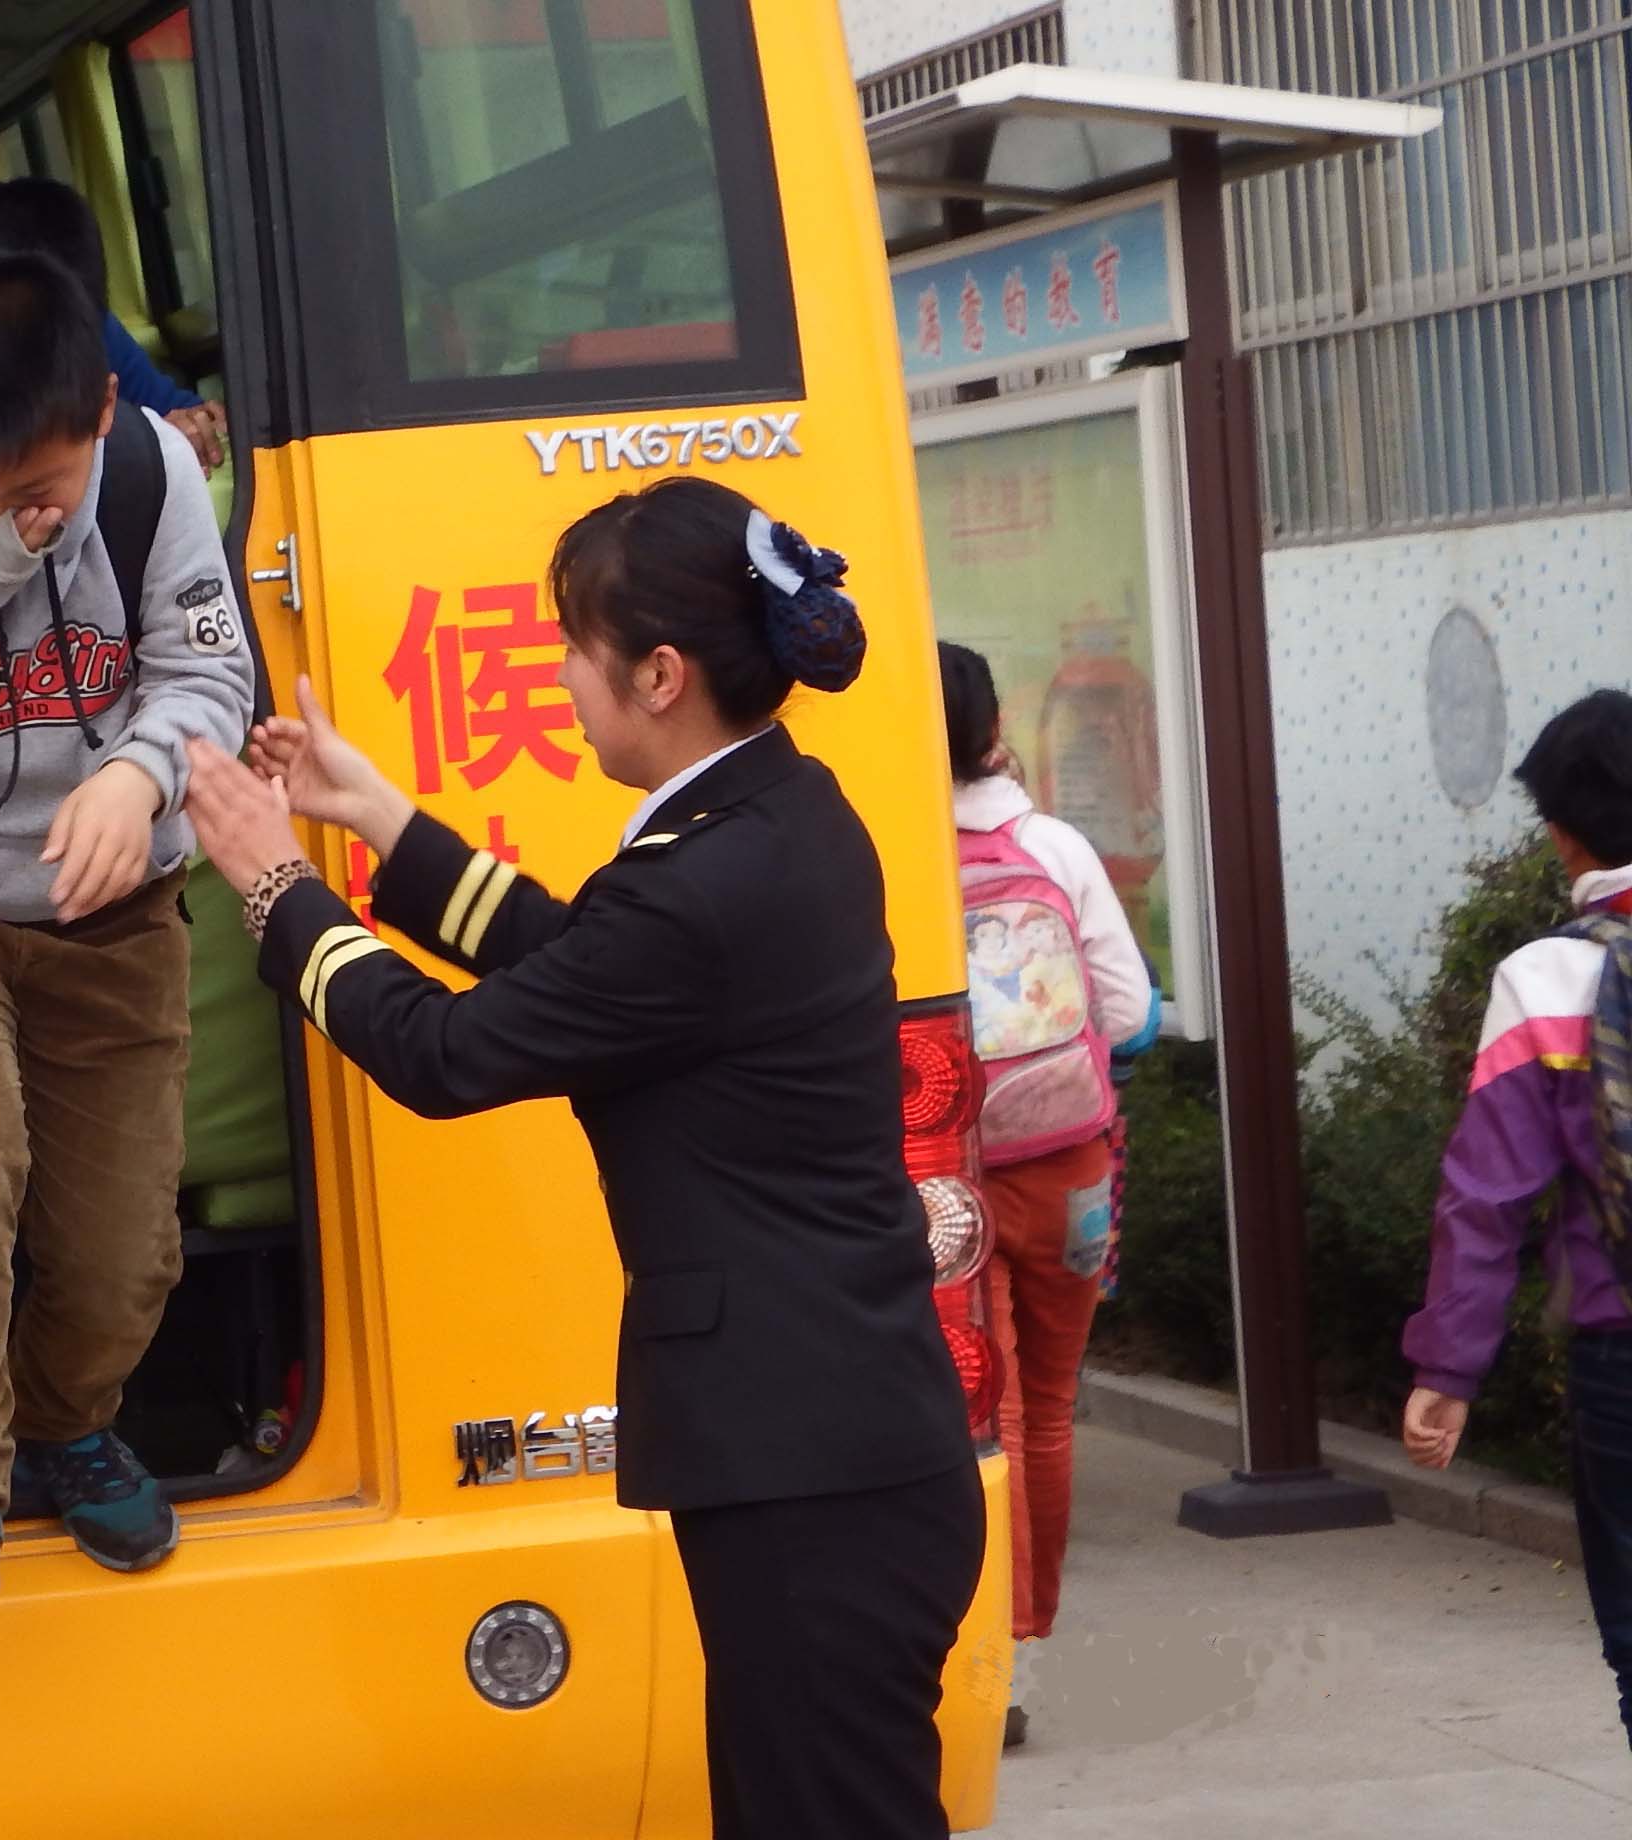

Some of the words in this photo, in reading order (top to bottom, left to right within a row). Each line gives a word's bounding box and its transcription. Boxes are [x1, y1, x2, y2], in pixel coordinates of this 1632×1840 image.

[524, 412, 802, 474] YTK6750X
[197, 608, 234, 646] 66
[382, 583, 582, 795] 候
